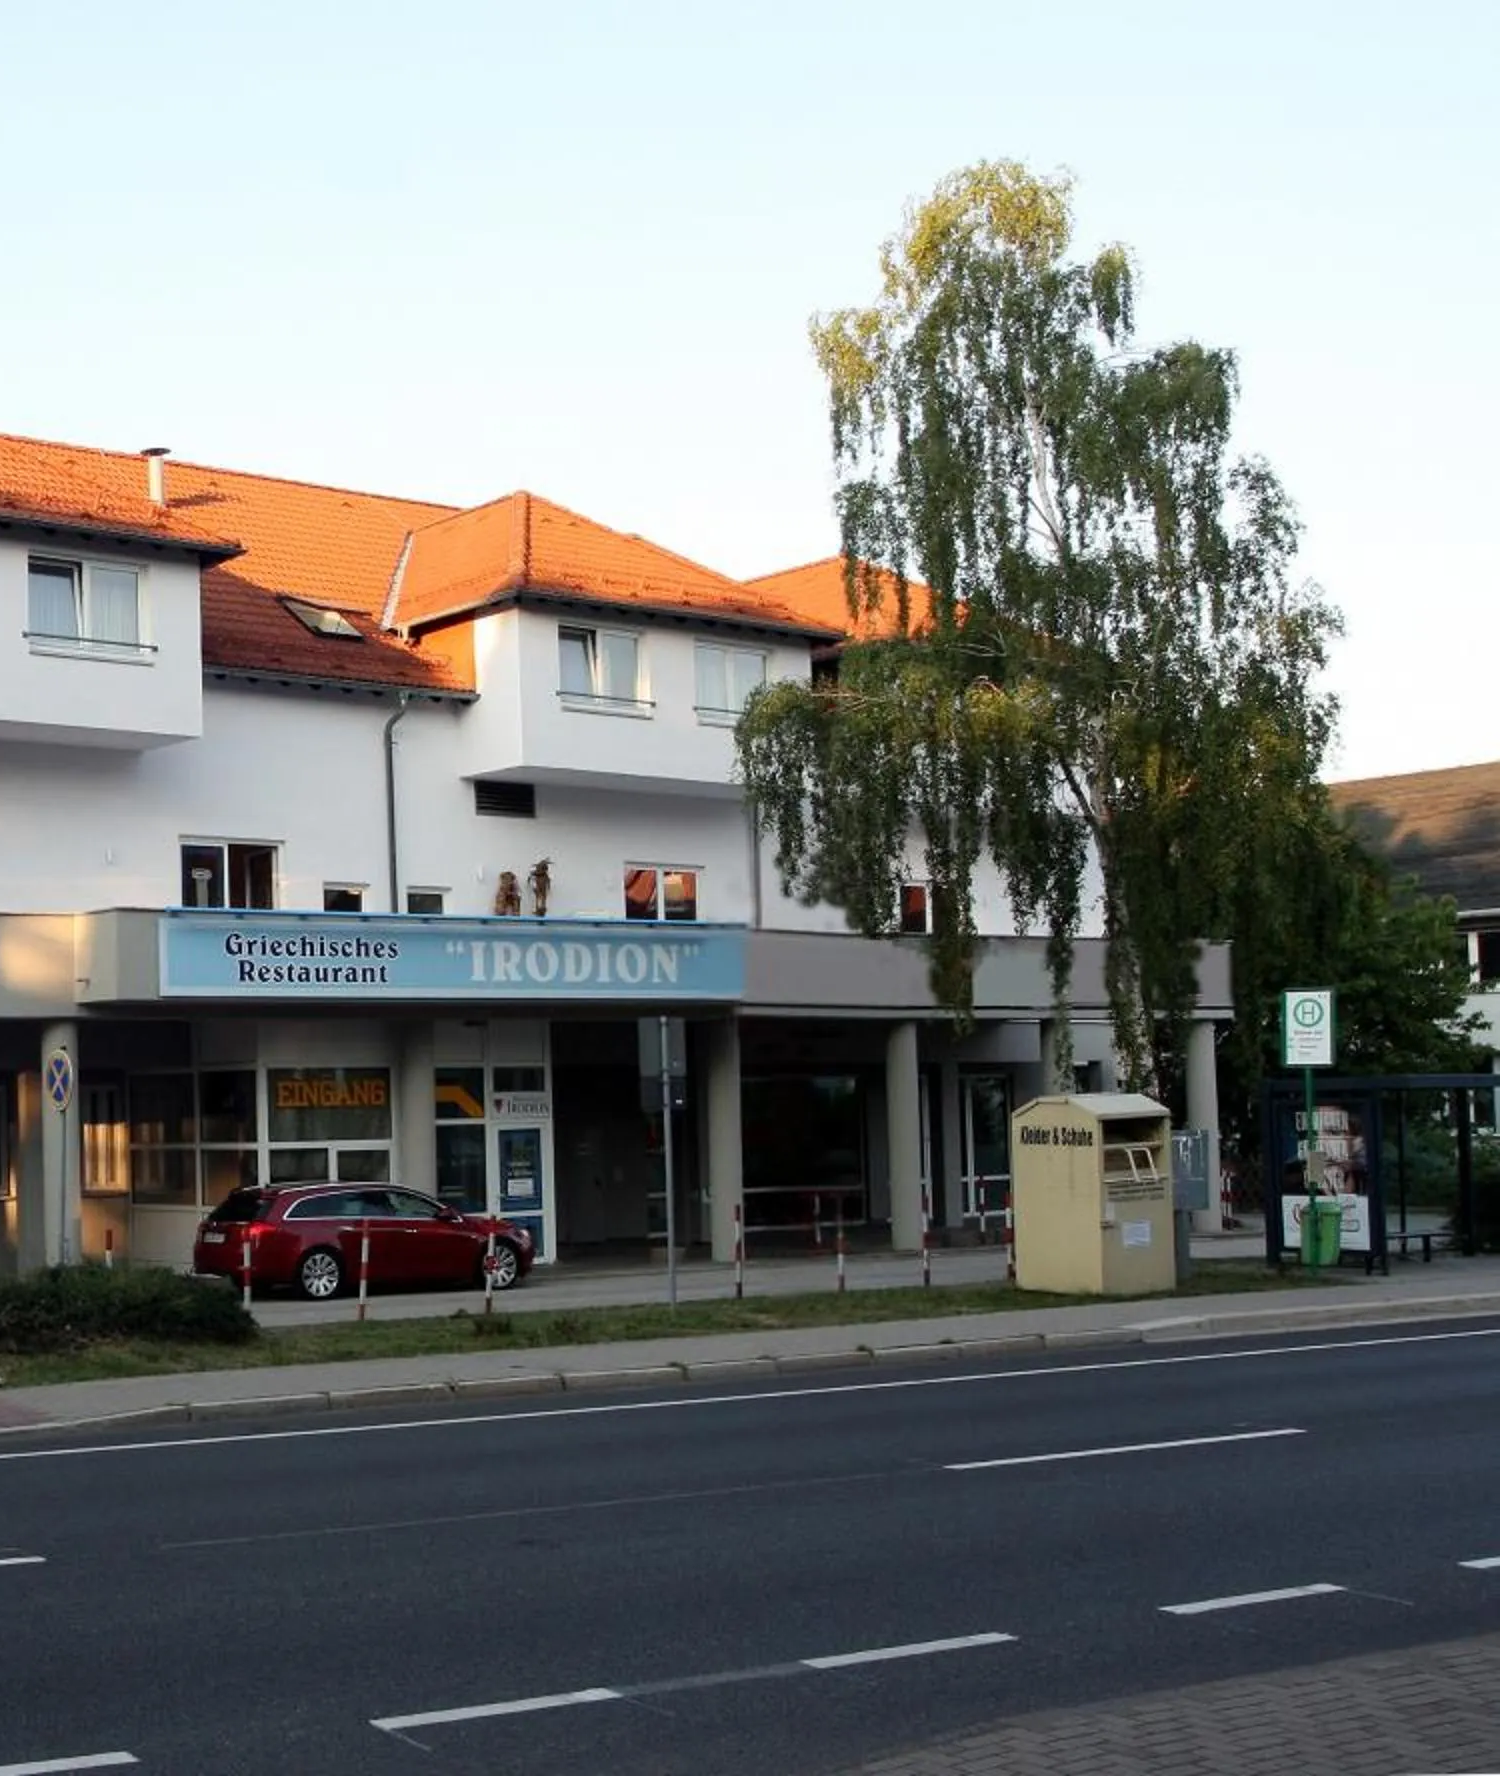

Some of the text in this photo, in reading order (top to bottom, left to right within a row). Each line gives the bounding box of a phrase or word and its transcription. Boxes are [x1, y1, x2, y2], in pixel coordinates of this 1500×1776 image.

[224, 932, 399, 959] Griechisches
[238, 959, 388, 983] Restaurant
[276, 1081, 385, 1108] EINGANG
[1021, 1126, 1093, 1147] Kleider & Schuhe
